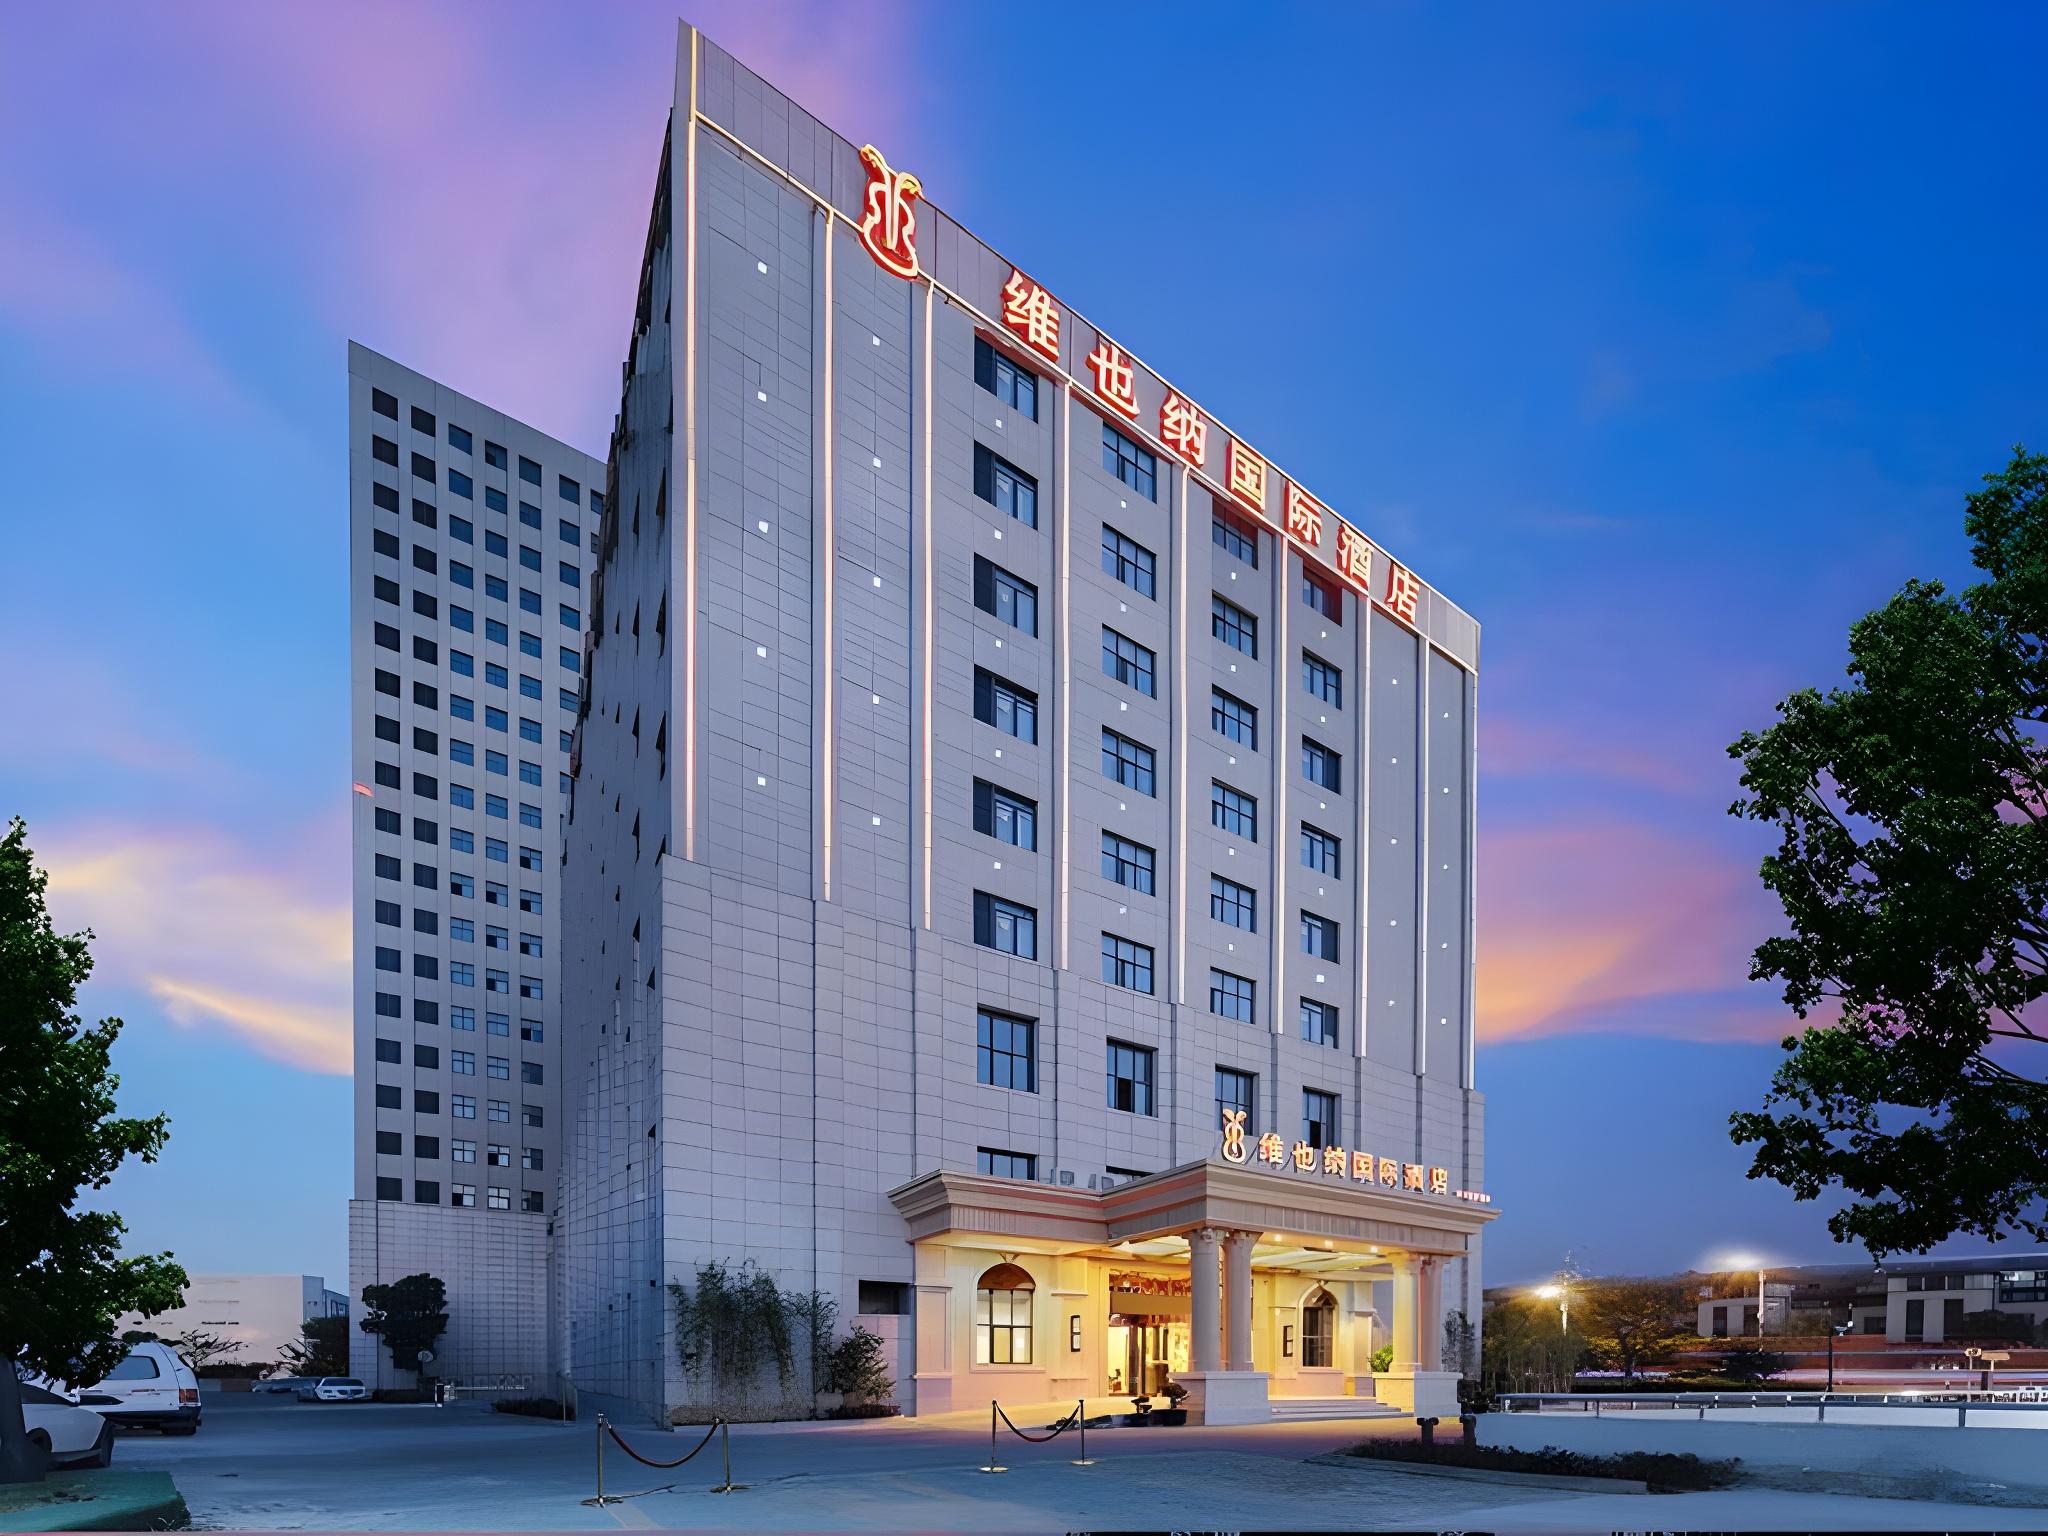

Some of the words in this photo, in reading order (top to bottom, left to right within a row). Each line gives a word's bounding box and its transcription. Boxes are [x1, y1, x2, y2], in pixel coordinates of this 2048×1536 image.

[1002, 268, 1420, 624] 维也纳国际酒店
